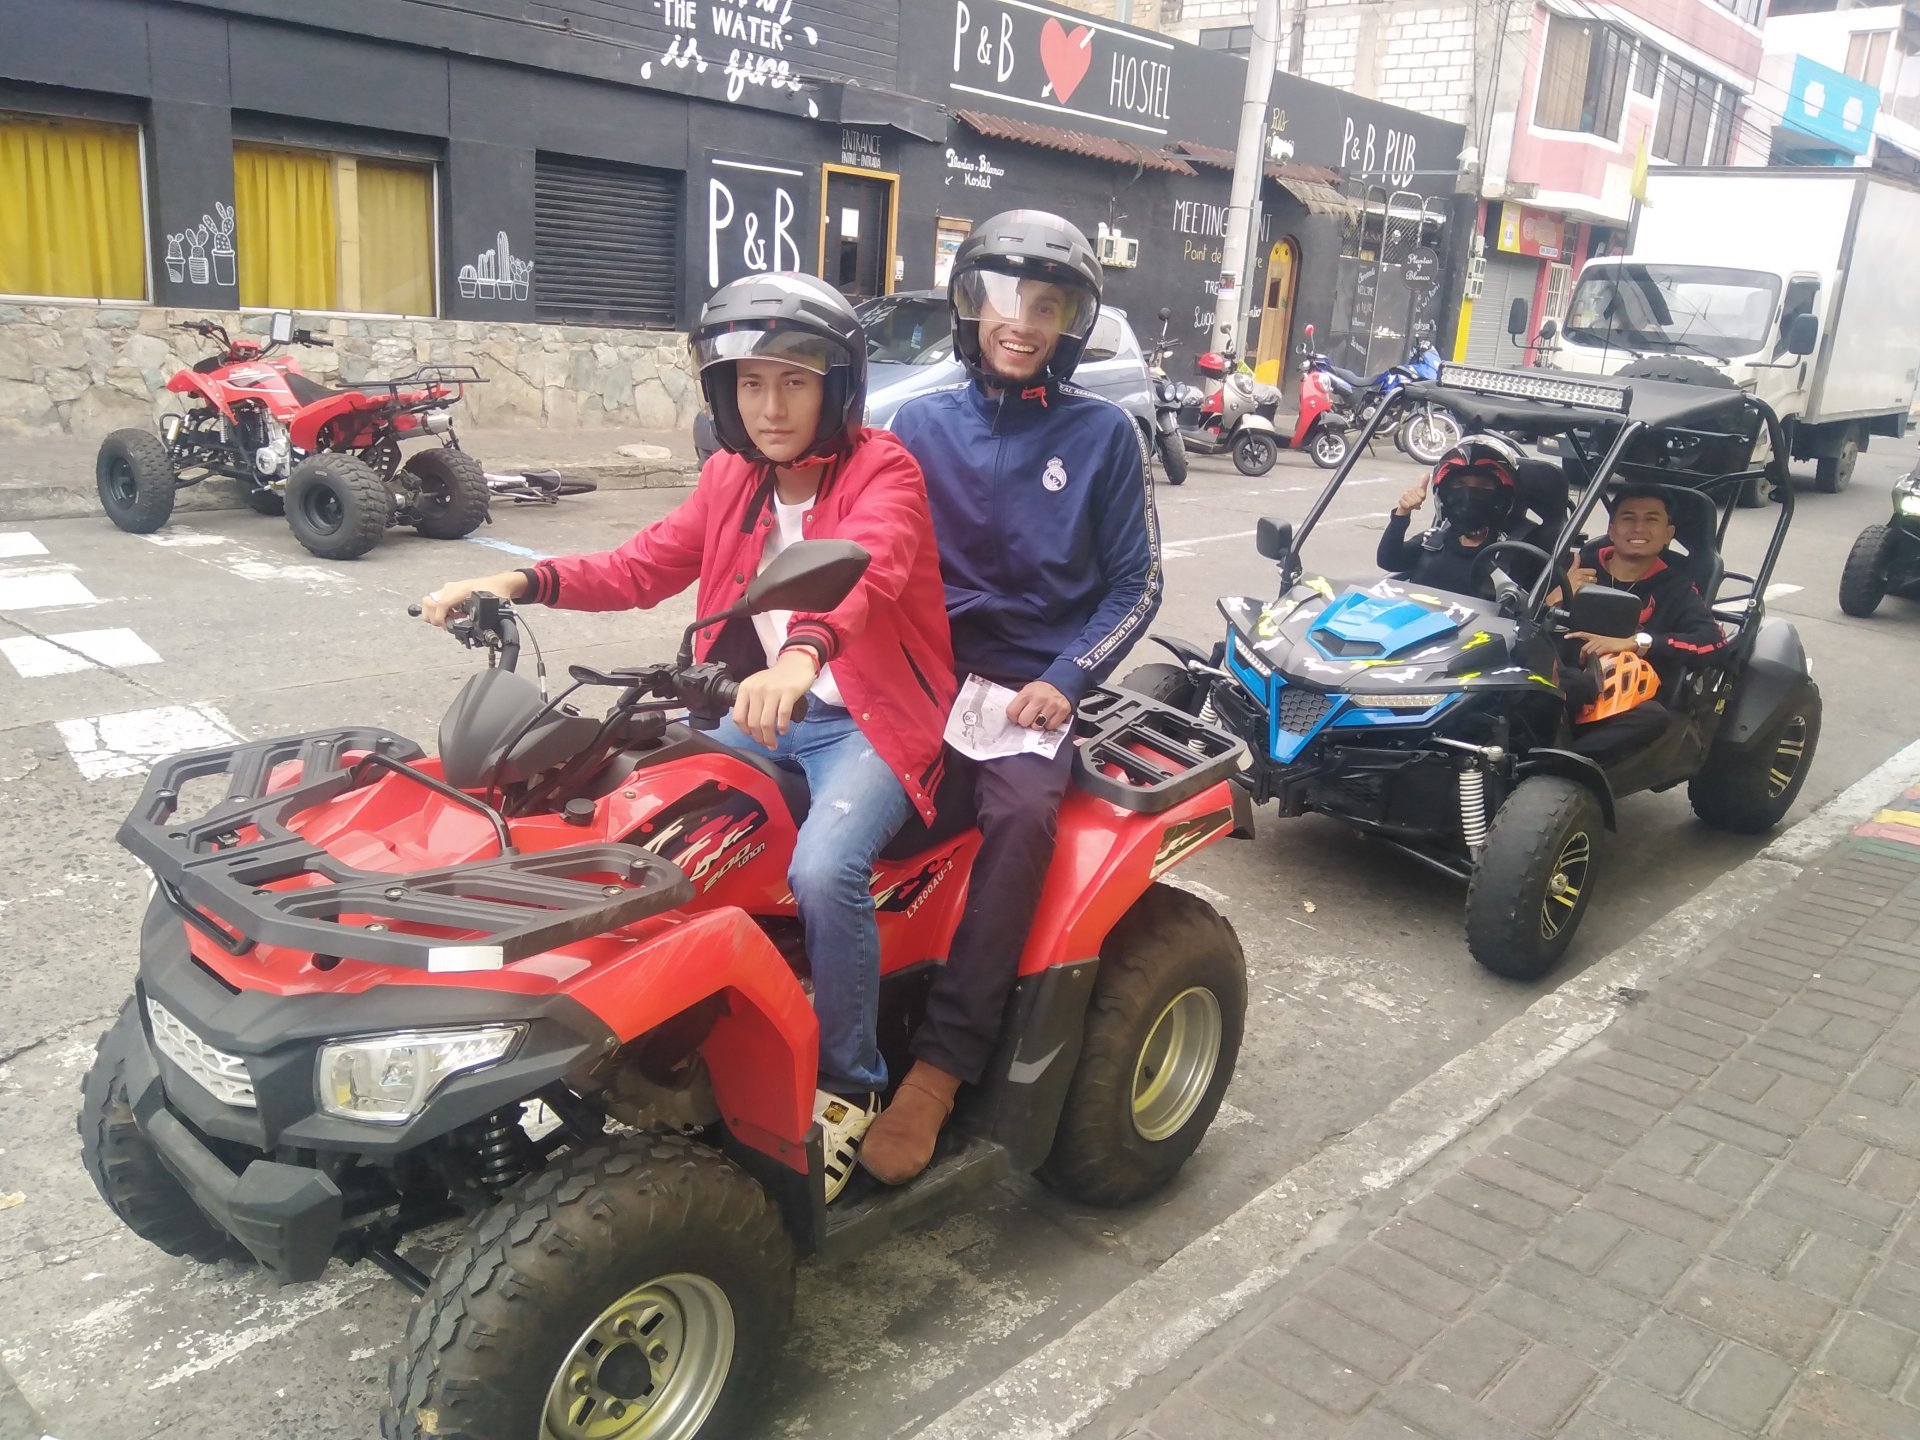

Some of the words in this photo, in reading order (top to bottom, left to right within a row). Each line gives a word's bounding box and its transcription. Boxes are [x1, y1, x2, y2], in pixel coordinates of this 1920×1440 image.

[1109, 51, 1170, 120] HOSTEL
[842, 129, 882, 155] ENTRANCE
[1382, 129, 1416, 188] PUB
[965, 172, 992, 189] Hostel
[1173, 200, 1230, 238] MEETING
[1147, 508, 1155, 543] MADRID
[1148, 561, 1158, 581] REAL
[1122, 614, 1138, 632] REAL
[1100, 627, 1126, 653] MADRID
[906, 860, 954, 919] LX200AU-2
